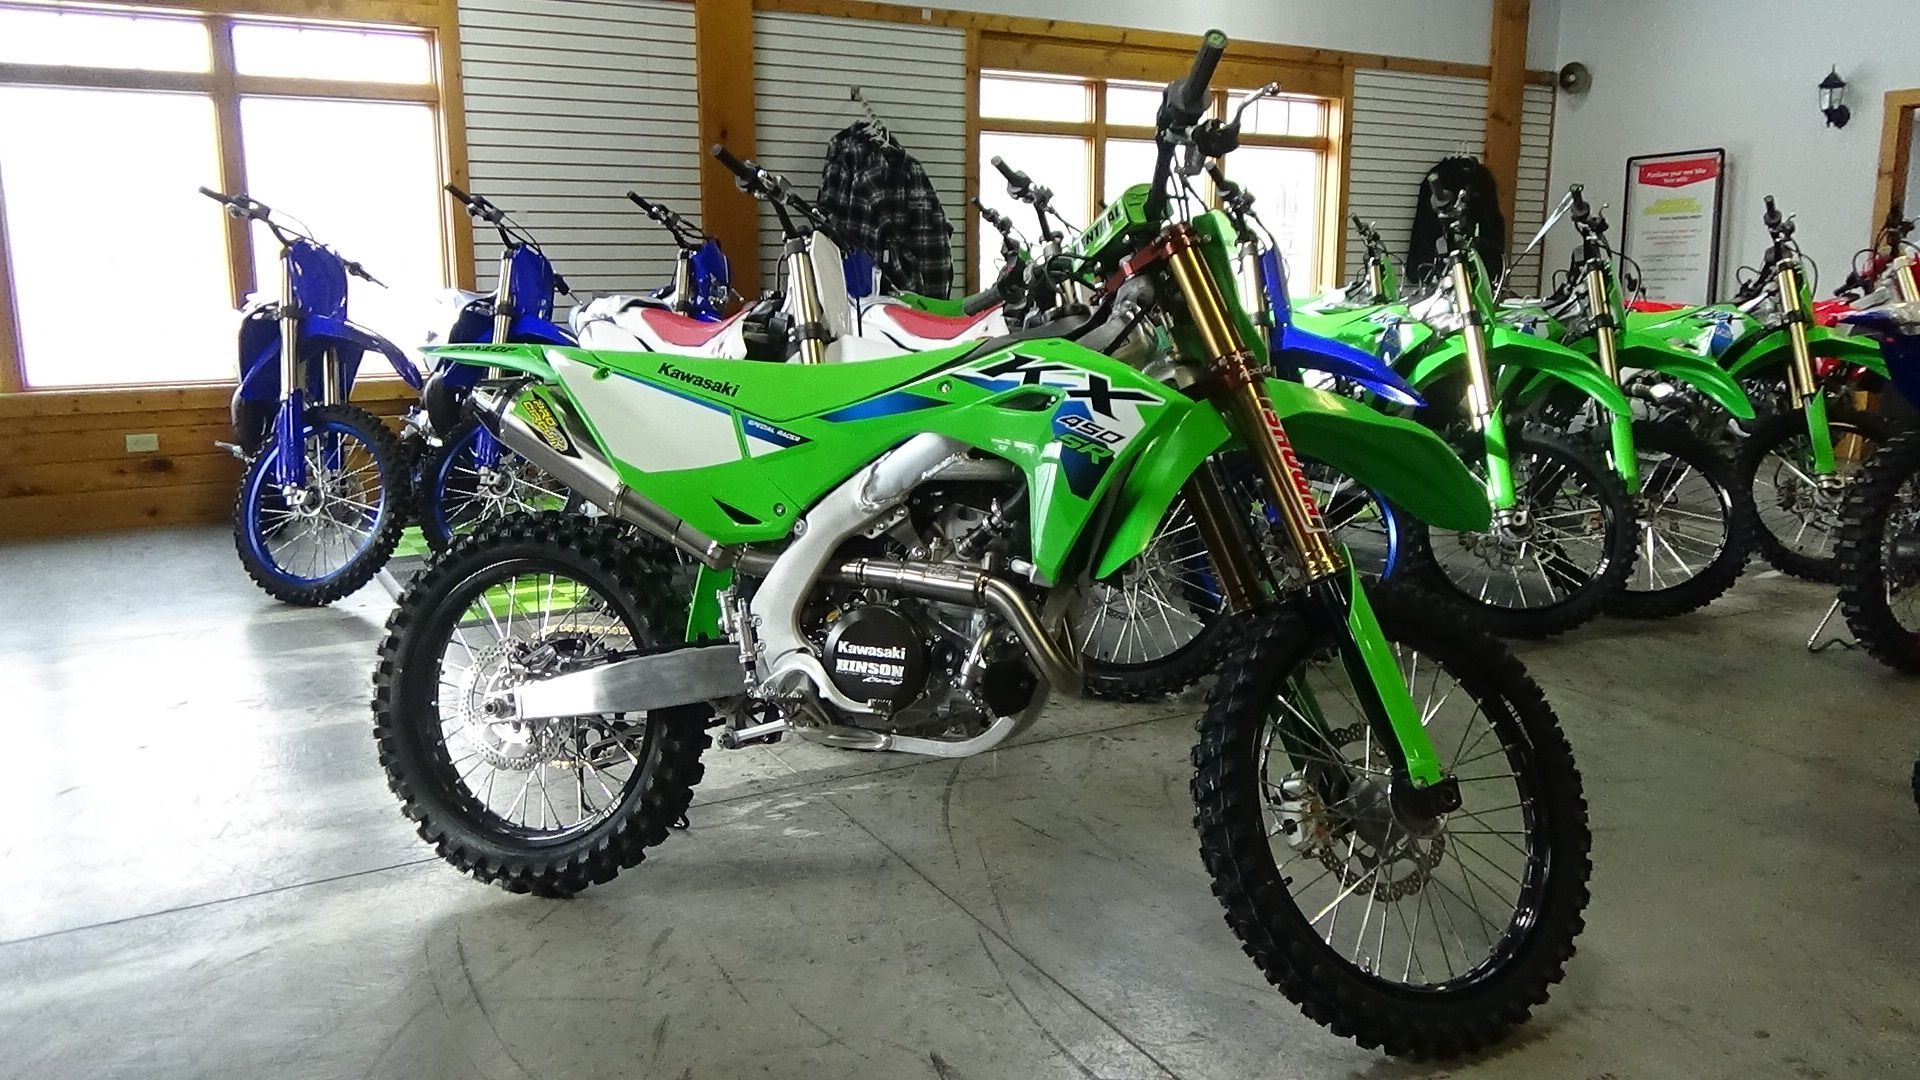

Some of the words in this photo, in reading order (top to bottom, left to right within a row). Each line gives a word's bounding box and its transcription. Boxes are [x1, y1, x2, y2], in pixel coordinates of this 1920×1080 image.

[657, 362, 740, 398] Kawasaki
[976, 353, 1164, 422] KX
[532, 399, 558, 428] PRO
[747, 419, 775, 434] SPECIAL
[776, 429, 801, 442] RACER
[1058, 415, 1127, 444] 450
[1060, 433, 1115, 465] SR
[837, 640, 906, 660] Kawasaki
[836, 659, 905, 678] HINSON
